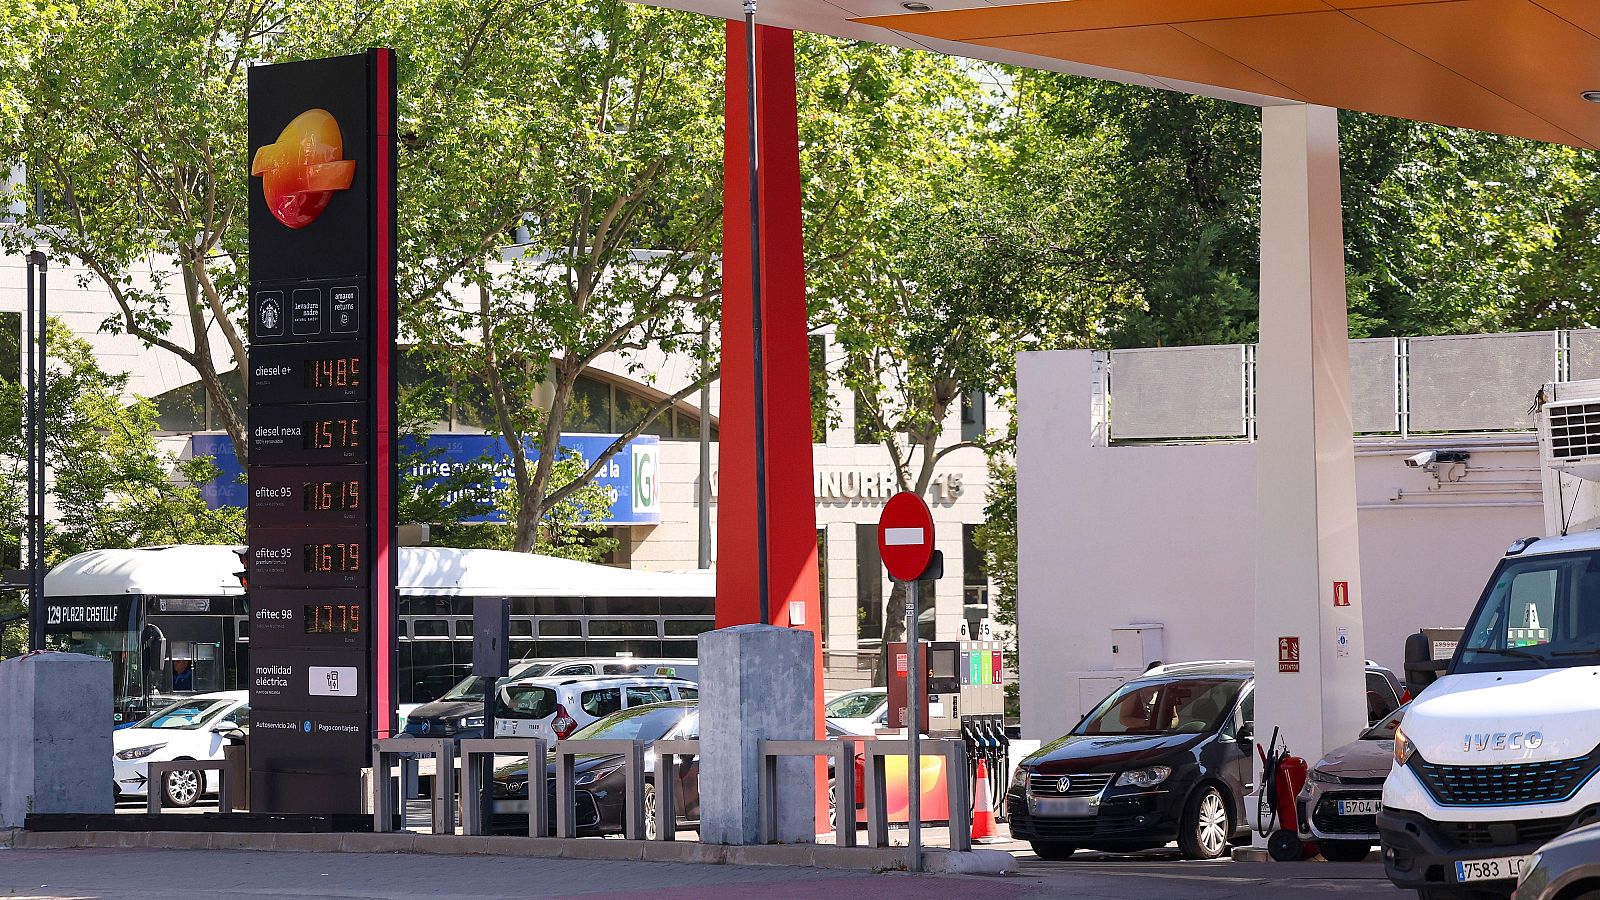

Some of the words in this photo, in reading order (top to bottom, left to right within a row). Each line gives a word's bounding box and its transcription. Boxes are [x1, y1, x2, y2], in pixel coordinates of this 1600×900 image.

[334, 303, 354, 311] returns
[255, 365, 281, 377] diesel
[281, 366, 292, 376] e+
[254, 426, 280, 437] diesel
[281, 427, 302, 437] nexa
[609, 459, 620, 478] la
[814, 471, 898, 498] INURR
[936, 473, 965, 498] 15
[255, 487, 280, 498] efitec
[280, 487, 292, 498] 95
[315, 480, 359, 510] 1.619
[255, 548, 280, 558] efitec
[280, 548, 292, 558] 95
[315, 543, 360, 571] 1.679
[47, 606, 61, 624] 129
[62, 606, 85, 622] PLAZA
[255, 609, 280, 620] efitec
[281, 609, 293, 620] 98
[960, 624, 966, 636] 6
[984, 624, 990, 635] 5
[256, 665, 292, 675] movilidad
[255, 676, 288, 687] eléctrica
[256, 721, 286, 729] Autoservicio
[287, 722, 297, 730] 24h
[318, 724, 332, 733] Pago
[342, 725, 359, 734] tarjeta
[1463, 730, 1544, 753] IVECO
[1345, 801, 1372, 813] 5704
[1375, 801, 1382, 813] M
[1464, 861, 1500, 879] 7583
